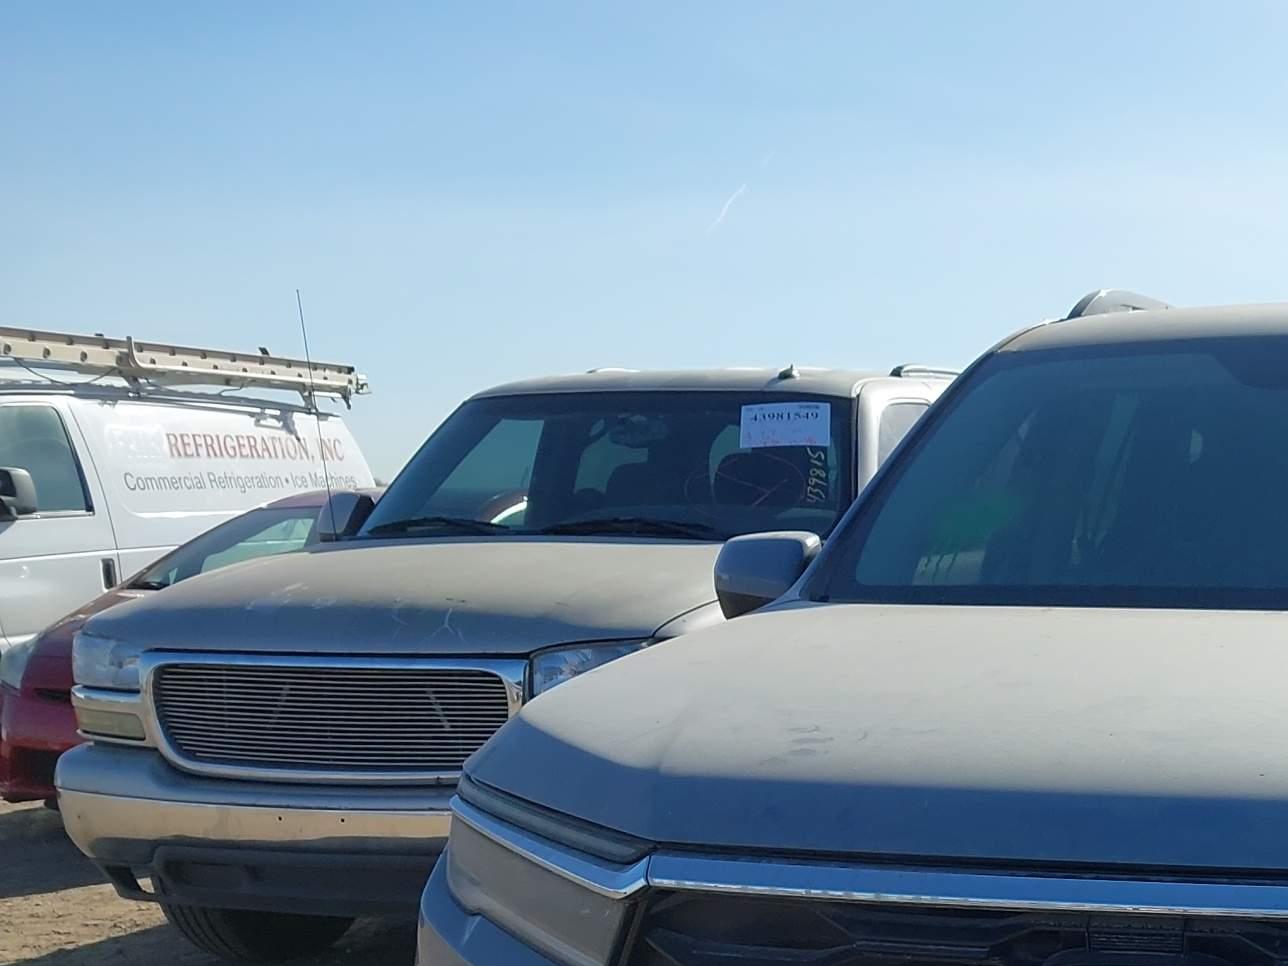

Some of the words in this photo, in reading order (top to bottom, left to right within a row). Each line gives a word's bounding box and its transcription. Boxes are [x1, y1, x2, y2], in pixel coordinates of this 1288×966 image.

[165, 432, 315, 462] REFRIGERATION,
[319, 437, 345, 461] INC
[123, 471, 206, 492] Commercial
[209, 472, 283, 494] Refrigeration
[291, 472, 310, 489] Ice
